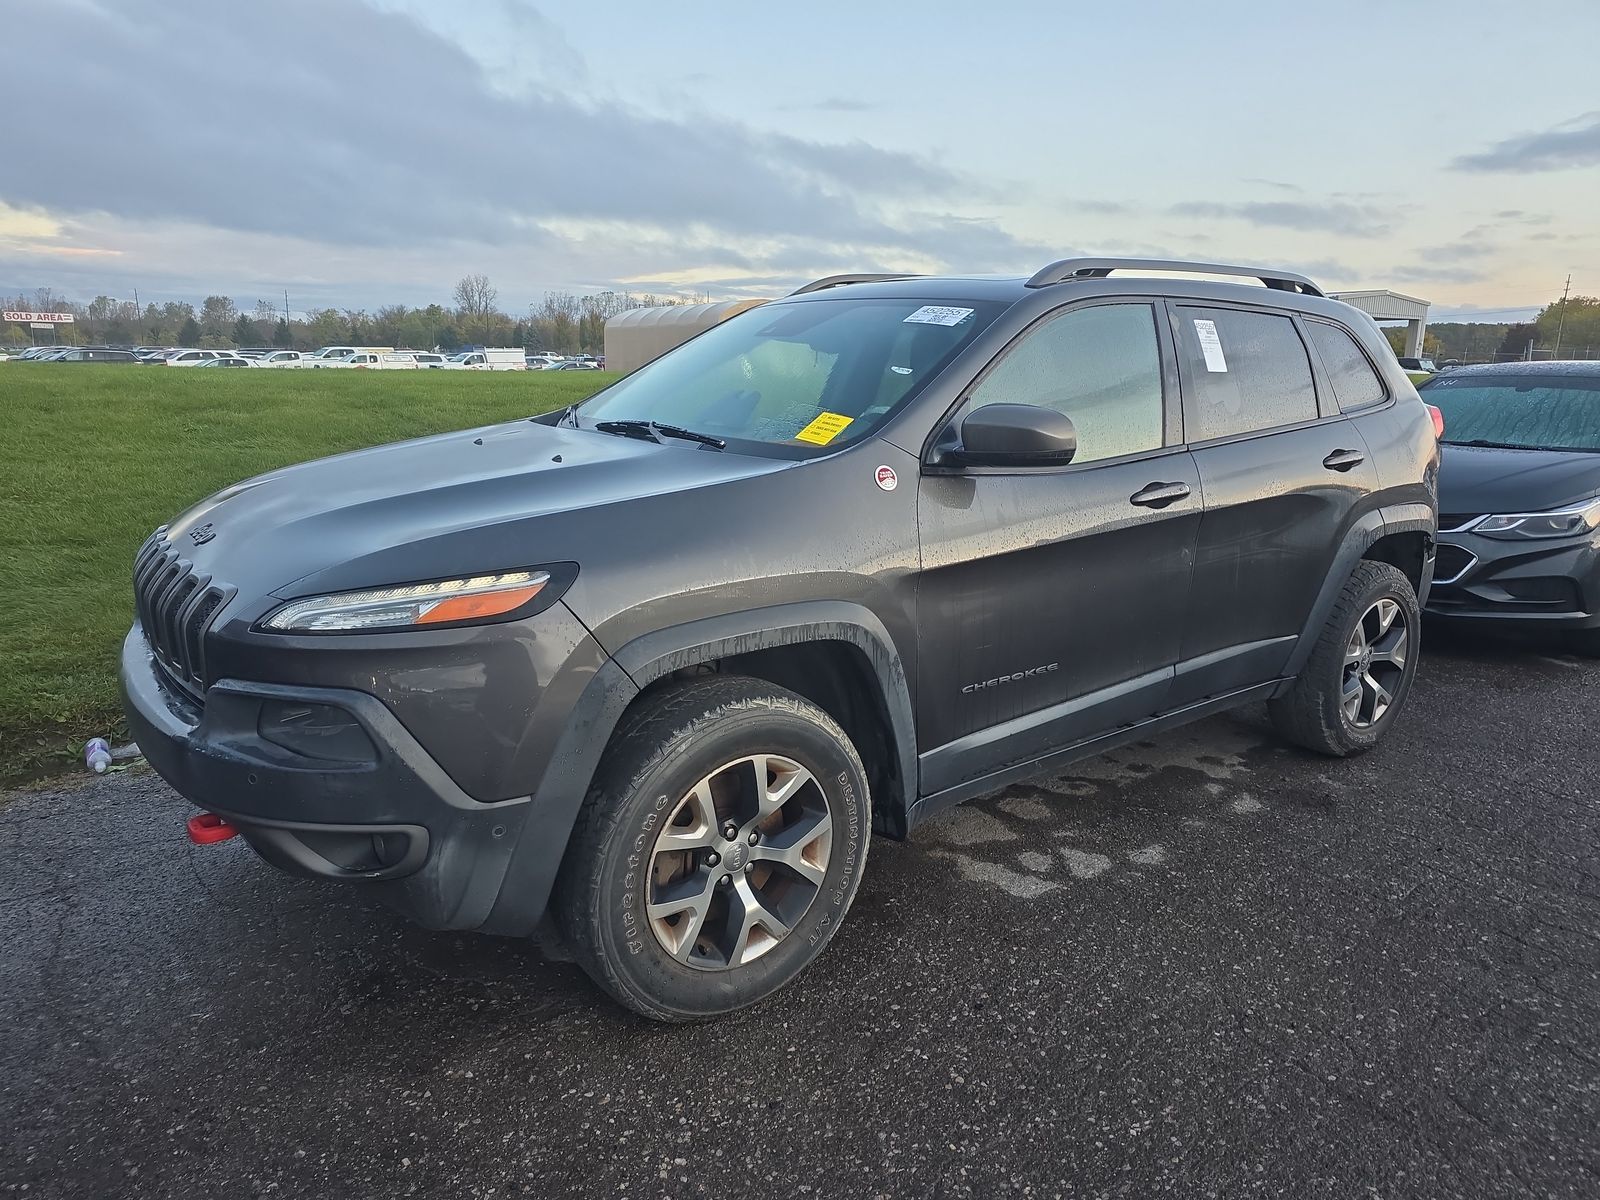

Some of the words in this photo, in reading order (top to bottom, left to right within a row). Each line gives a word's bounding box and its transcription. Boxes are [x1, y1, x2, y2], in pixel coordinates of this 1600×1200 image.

[5, 312, 32, 321] SOLD
[36, 313, 64, 322] AREA
[961, 662, 1059, 694] CHEROKEE
[621, 792, 671, 956] Firestone
[828, 770, 864, 906] DESTINATION
